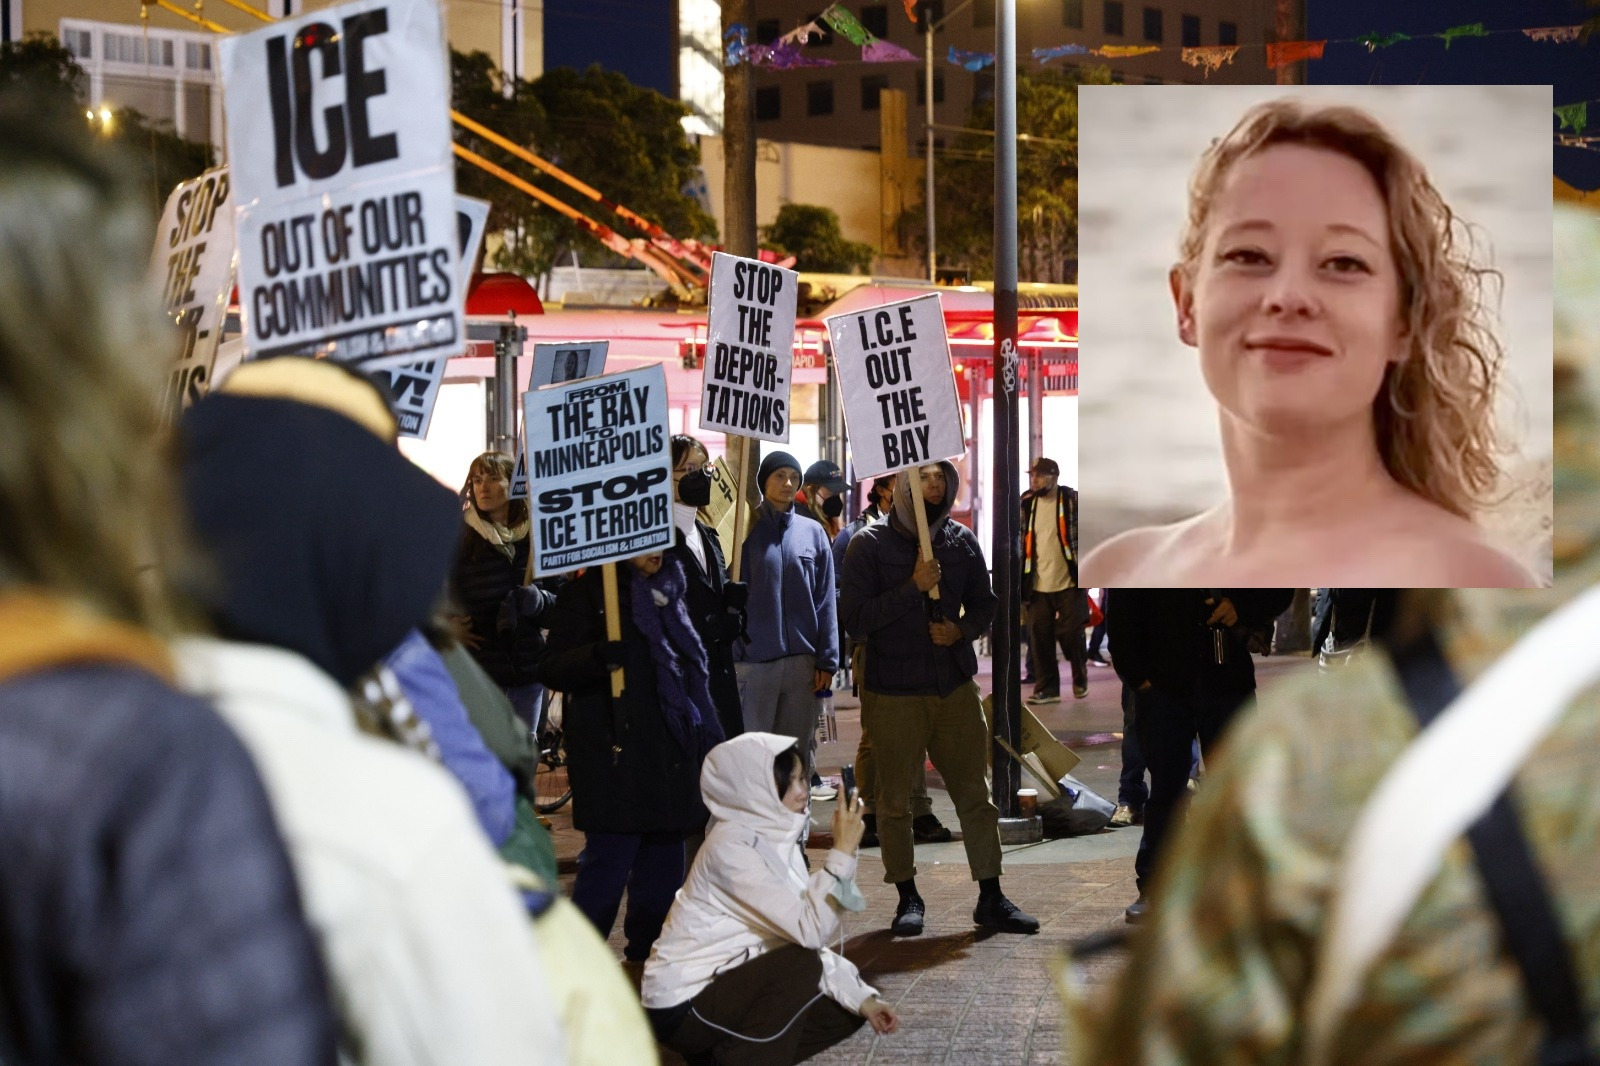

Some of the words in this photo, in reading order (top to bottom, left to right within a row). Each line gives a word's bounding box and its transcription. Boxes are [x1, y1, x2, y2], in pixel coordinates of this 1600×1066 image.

[266, 8, 399, 188] ICE
[170, 171, 230, 249] STOP
[262, 213, 315, 278] OUT
[322, 204, 353, 264] OF
[361, 191, 426, 255] OUR
[163, 242, 206, 307] THE
[253, 248, 452, 340] COMMUNITIES
[734, 261, 783, 306] STOP
[738, 304, 773, 347] THE
[858, 306, 917, 350] I.C.E
[714, 342, 784, 392] DEPOR-
[865, 347, 912, 389] OUT
[547, 399, 595, 442] THE
[601, 386, 649, 428] BAY
[568, 381, 627, 402] FROM
[707, 384, 785, 436] TATIONS
[877, 386, 926, 428] THE
[534, 424, 664, 479] MINNEAPOLIS
[586, 427, 613, 440] TO
[882, 425, 930, 469] BAY
[538, 467, 667, 514] STOP
[540, 516, 577, 550] ICE
[581, 493, 669, 542] TERROR
[542, 555, 566, 567] PARTY
[567, 553, 580, 563] FOR
[580, 542, 619, 559] SOCIALISM
[620, 542, 629, 550] &
[629, 531, 668, 549] LIBERATION
